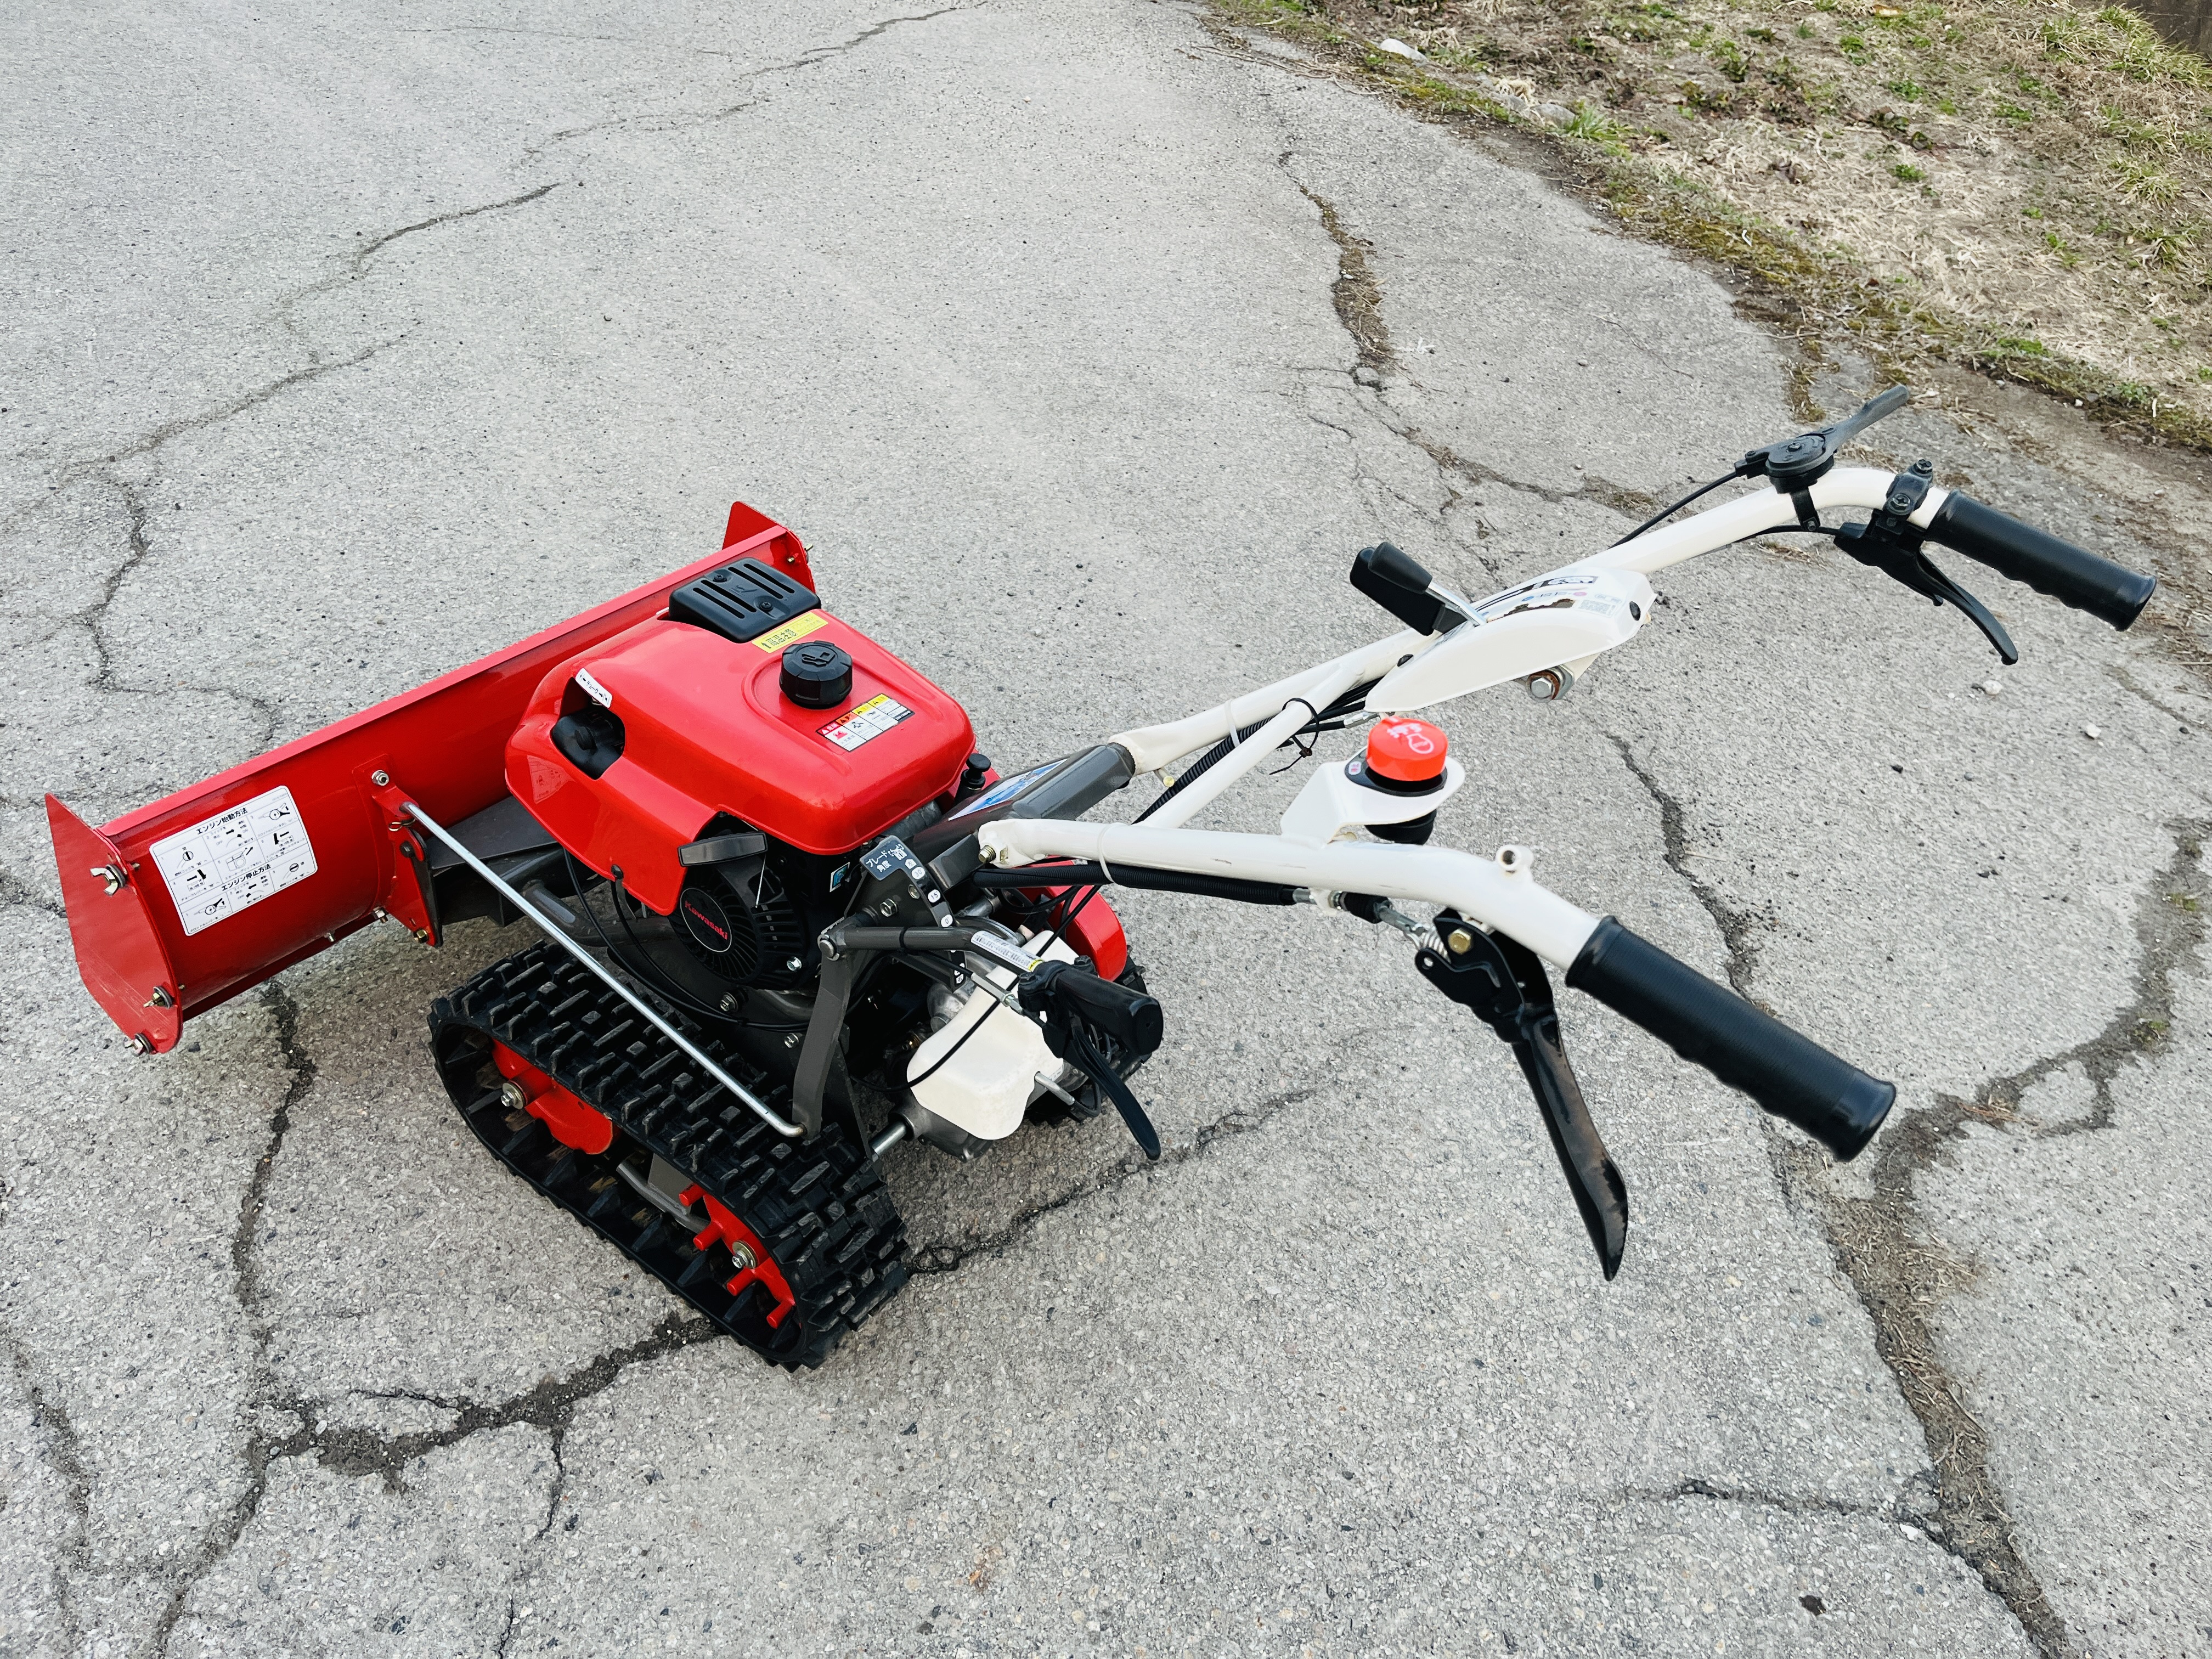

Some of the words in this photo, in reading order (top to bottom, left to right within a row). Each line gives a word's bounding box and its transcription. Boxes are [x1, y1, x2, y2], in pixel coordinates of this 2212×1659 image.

[196, 806, 247, 835] エンジン始動方法
[866, 850, 889, 868] ブレード
[877, 860, 892, 873] 角度
[220, 863, 271, 891] エンジン停止方法
[685, 900, 728, 940] Kawasaki
